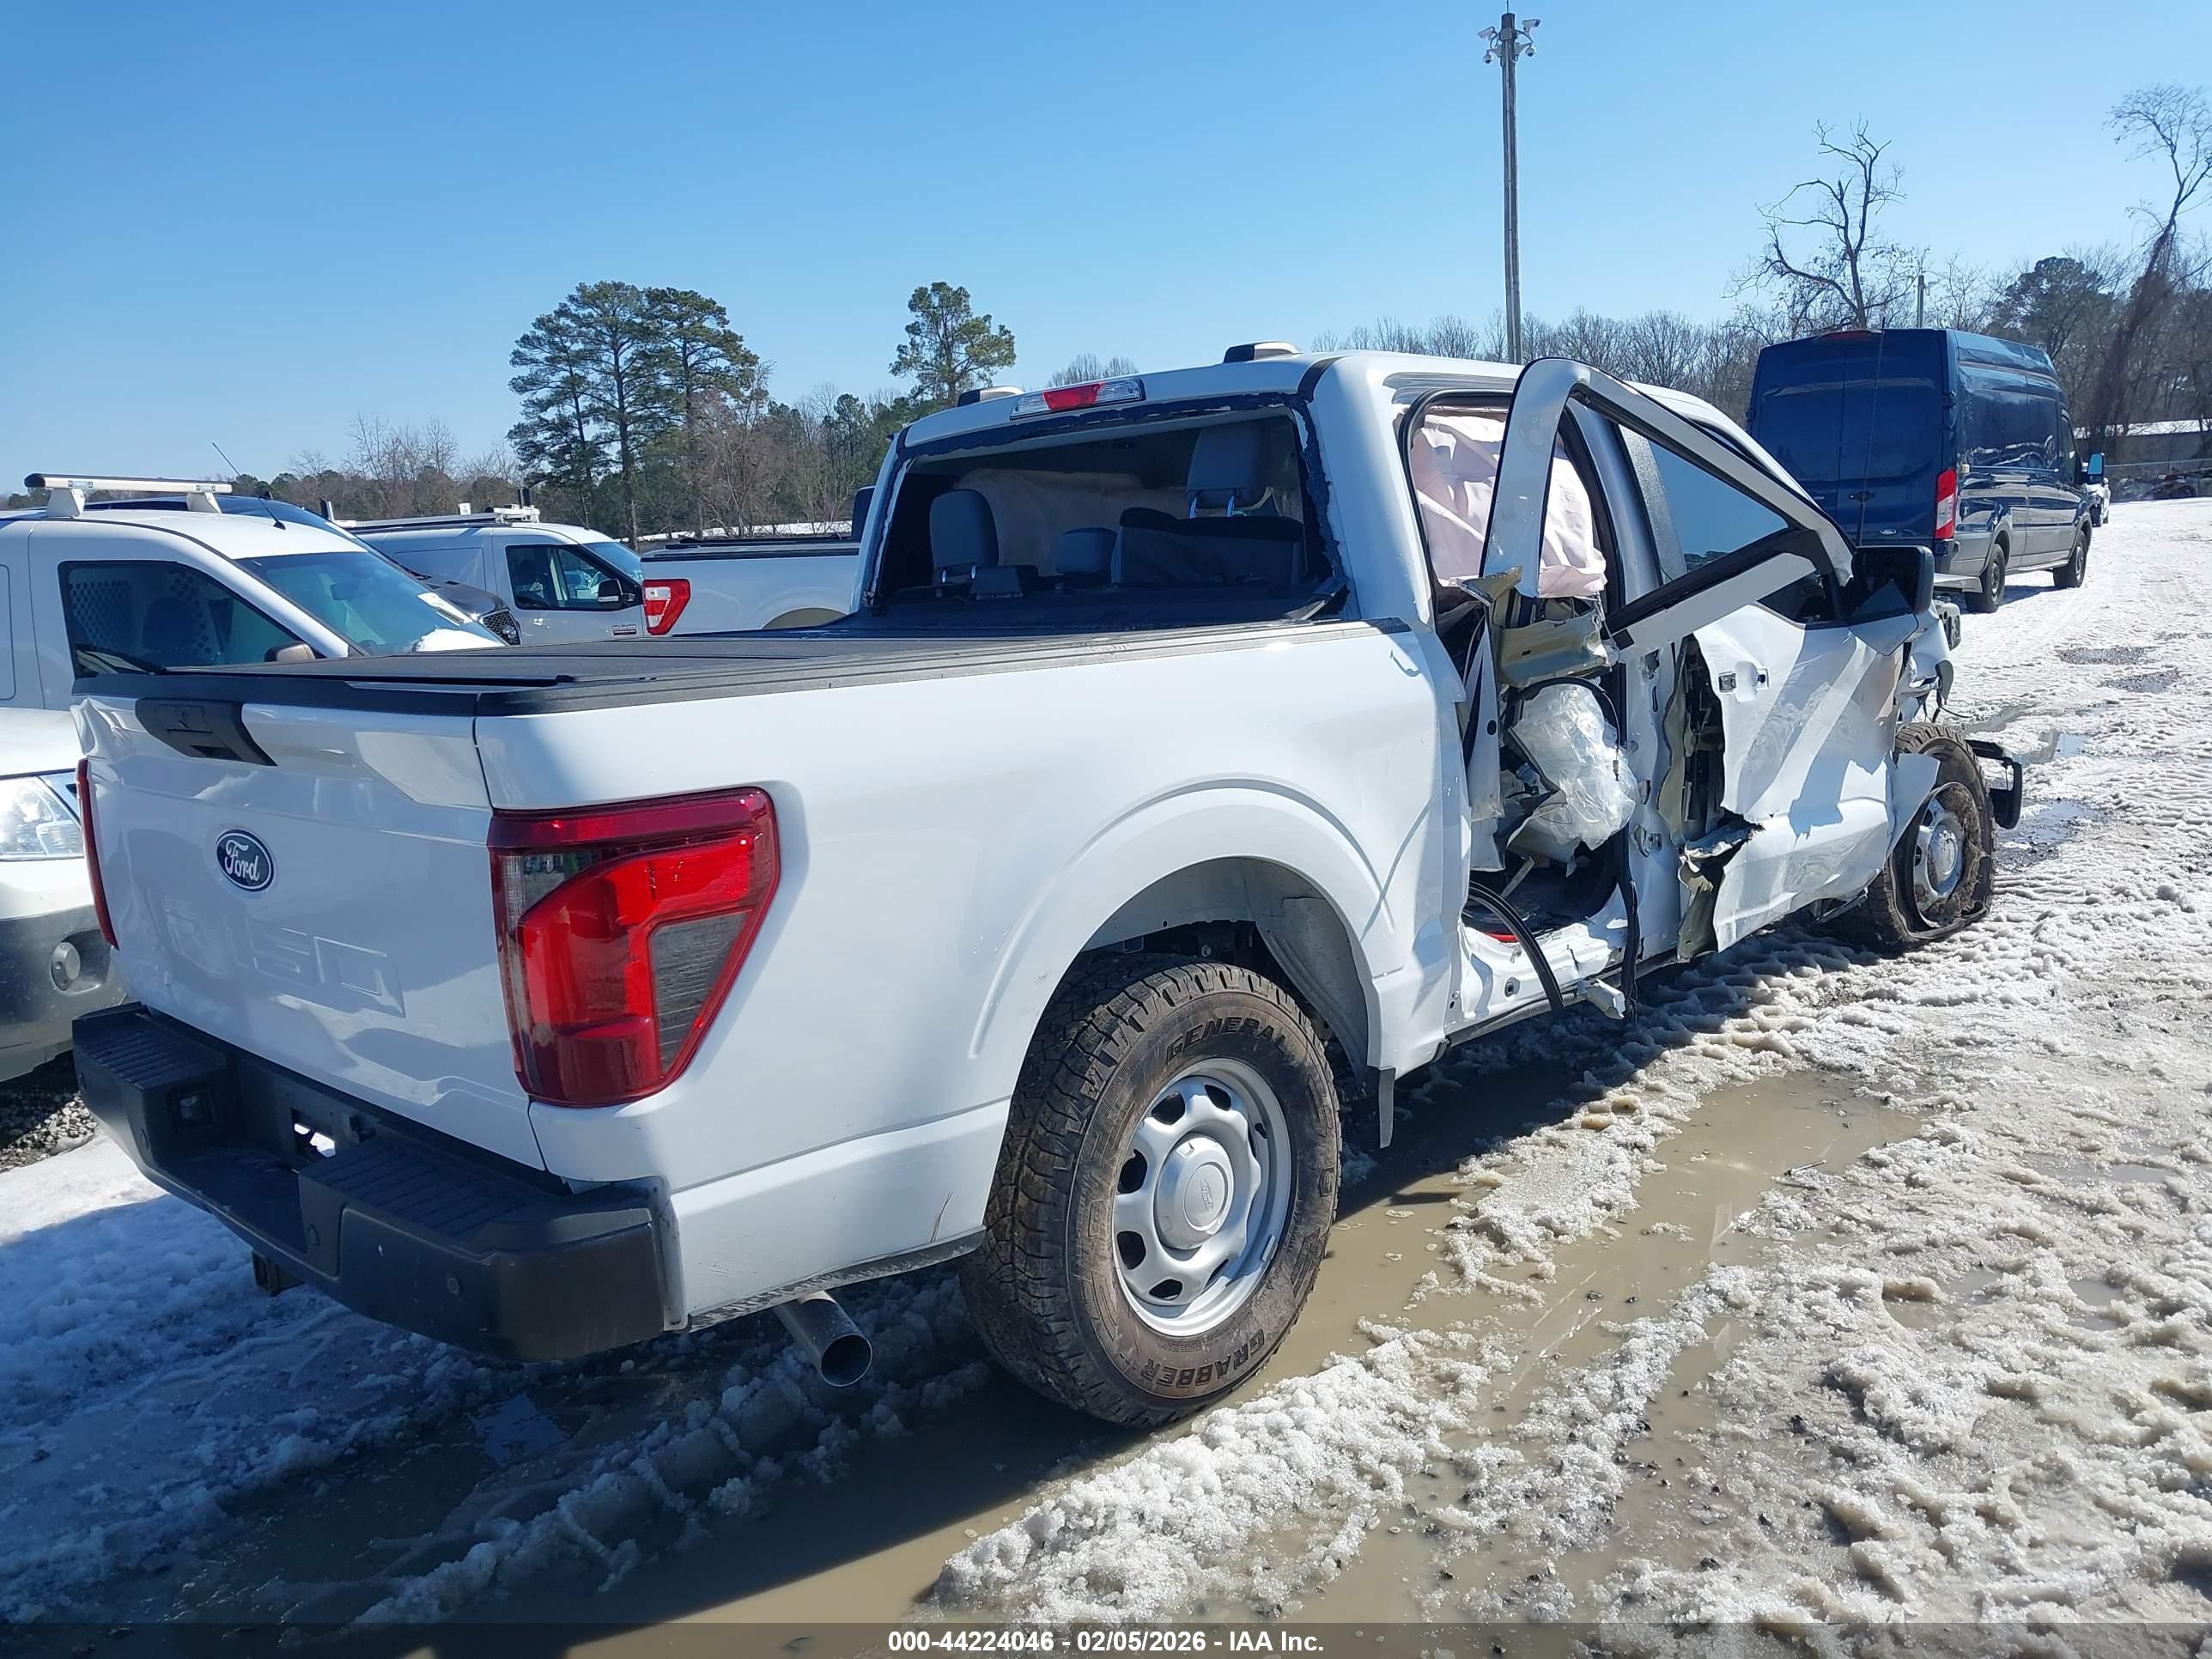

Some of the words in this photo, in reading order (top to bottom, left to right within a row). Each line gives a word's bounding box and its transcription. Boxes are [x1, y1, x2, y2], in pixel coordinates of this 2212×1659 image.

[224, 839, 260, 881] Ford
[1166, 1016, 1285, 1065] GENERAL
[1140, 1328, 1265, 1389] GRABBER
